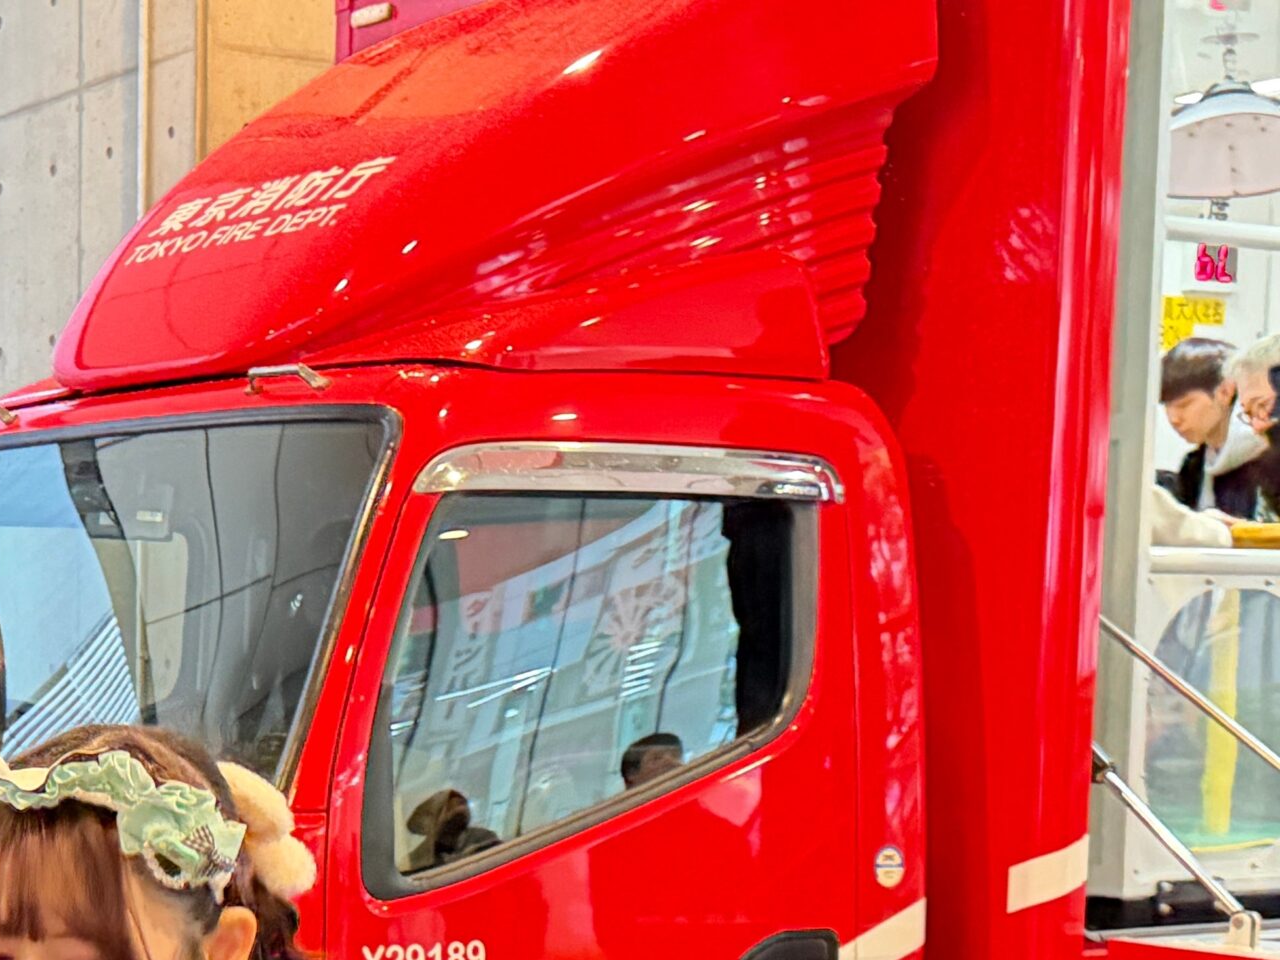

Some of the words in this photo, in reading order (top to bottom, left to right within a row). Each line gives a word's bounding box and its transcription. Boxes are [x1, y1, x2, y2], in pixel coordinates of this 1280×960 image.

[148, 156, 397, 238] 東京消防庁
[124, 230, 209, 266] TOKYO
[202, 218, 271, 249] FIRE
[262, 203, 348, 237] DEPT.
